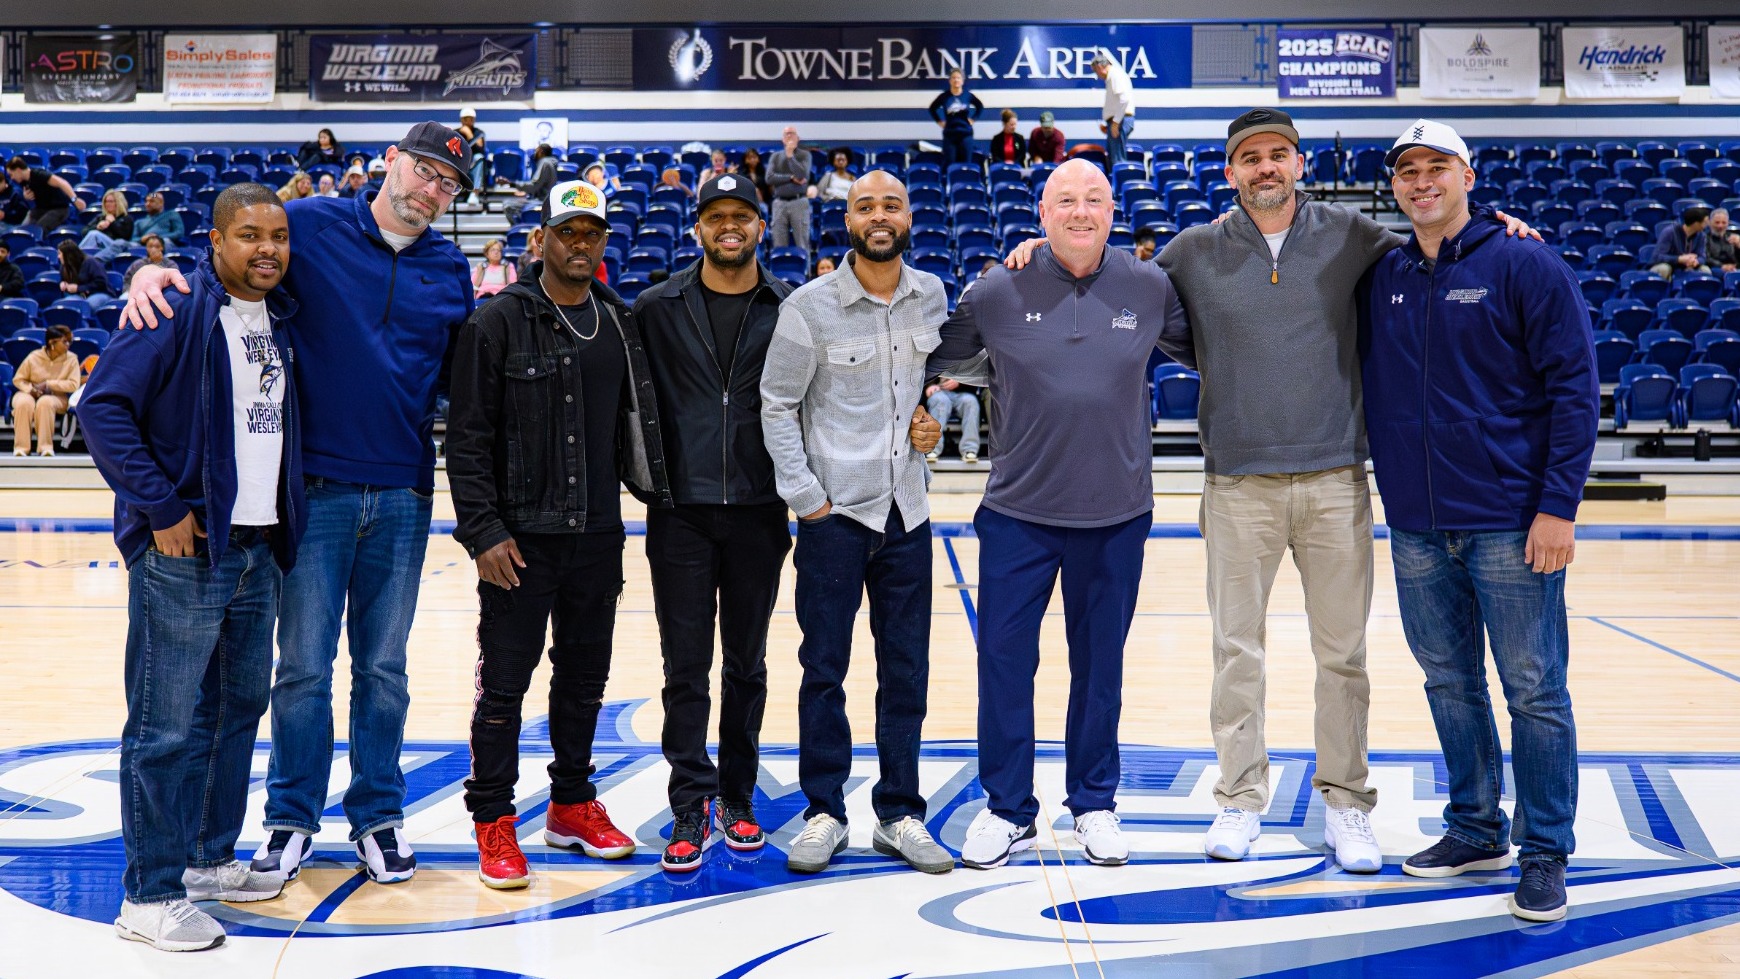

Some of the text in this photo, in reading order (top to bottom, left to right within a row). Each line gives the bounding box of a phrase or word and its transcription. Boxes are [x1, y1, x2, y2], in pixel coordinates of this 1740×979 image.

[328, 44, 439, 63] VIRGINIA
[1279, 34, 1390, 58] 2025 ECAC
[31, 50, 134, 73] ASTRO
[1003, 36, 1157, 80] ARENA
[1447, 58, 1509, 68] BOLDSPIRE
[1578, 45, 1667, 70] Hendrick
[322, 64, 441, 80] WESLEYAN
[1279, 62, 1381, 75] CHAMPIONS
[364, 84, 381, 92] WE
[445, 72, 526, 90] MARLINS
[1308, 79, 1363, 87] DIVISION III
[1289, 87, 1382, 96] MEN'S BASKETBALL
[240, 335, 278, 350] VIRGIN
[245, 349, 281, 364] WESLEY
